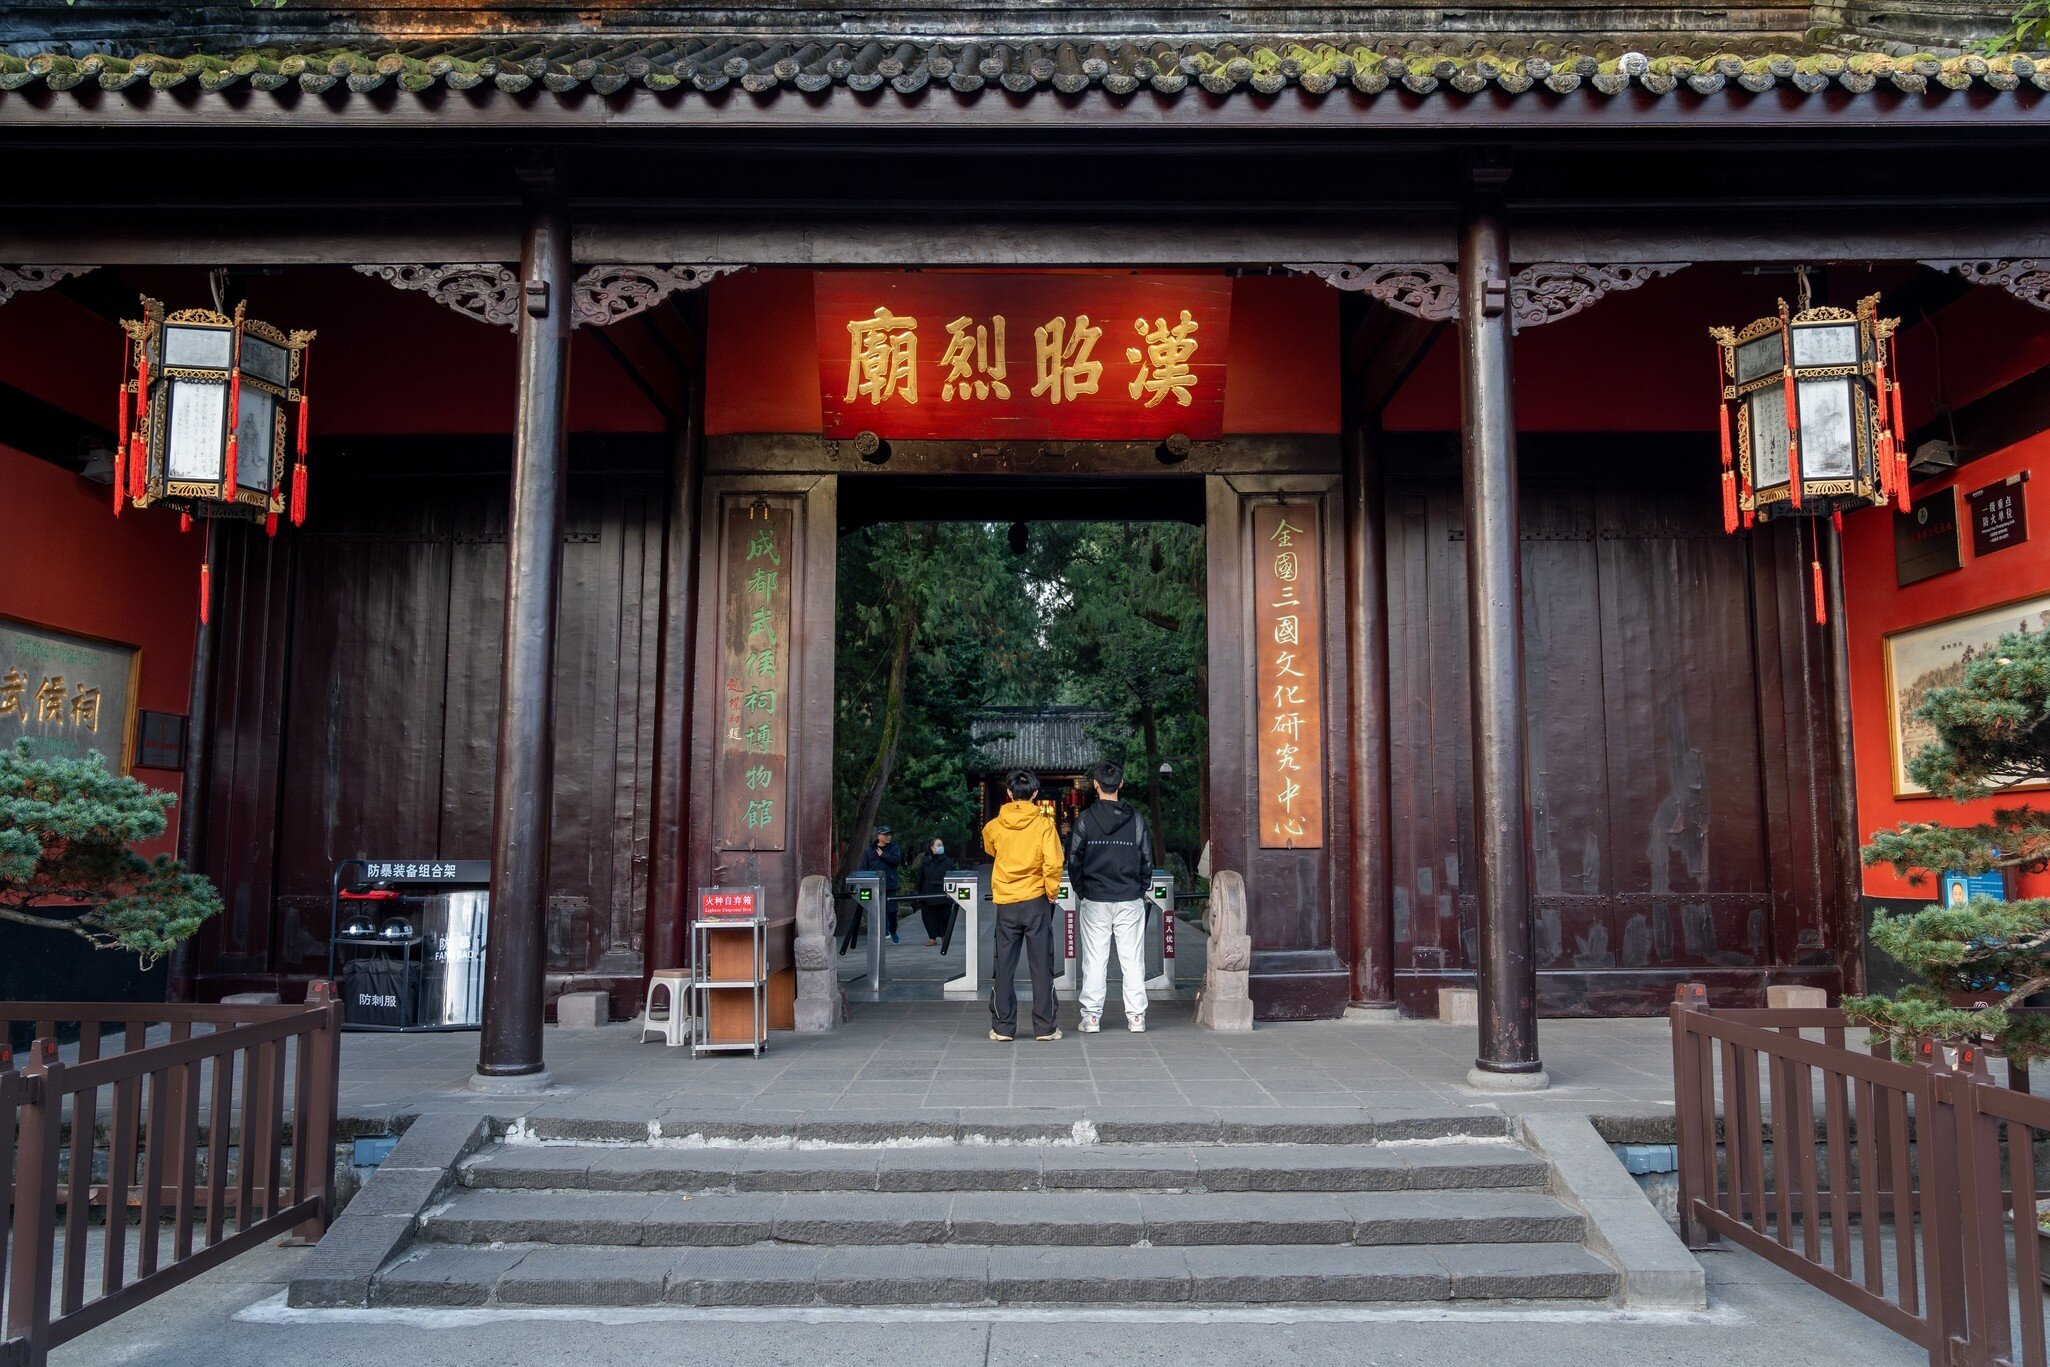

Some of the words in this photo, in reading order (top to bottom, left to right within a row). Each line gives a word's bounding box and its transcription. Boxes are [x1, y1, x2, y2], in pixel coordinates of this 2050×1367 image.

[843, 306, 1199, 408] 漢昭烈廟
[367, 863, 456, 878] 防暴装备组合架
[705, 895, 752, 906] 火种自弃箱
[1165, 915, 1174, 953] 军人优先
[359, 993, 397, 1007] 防刺服
